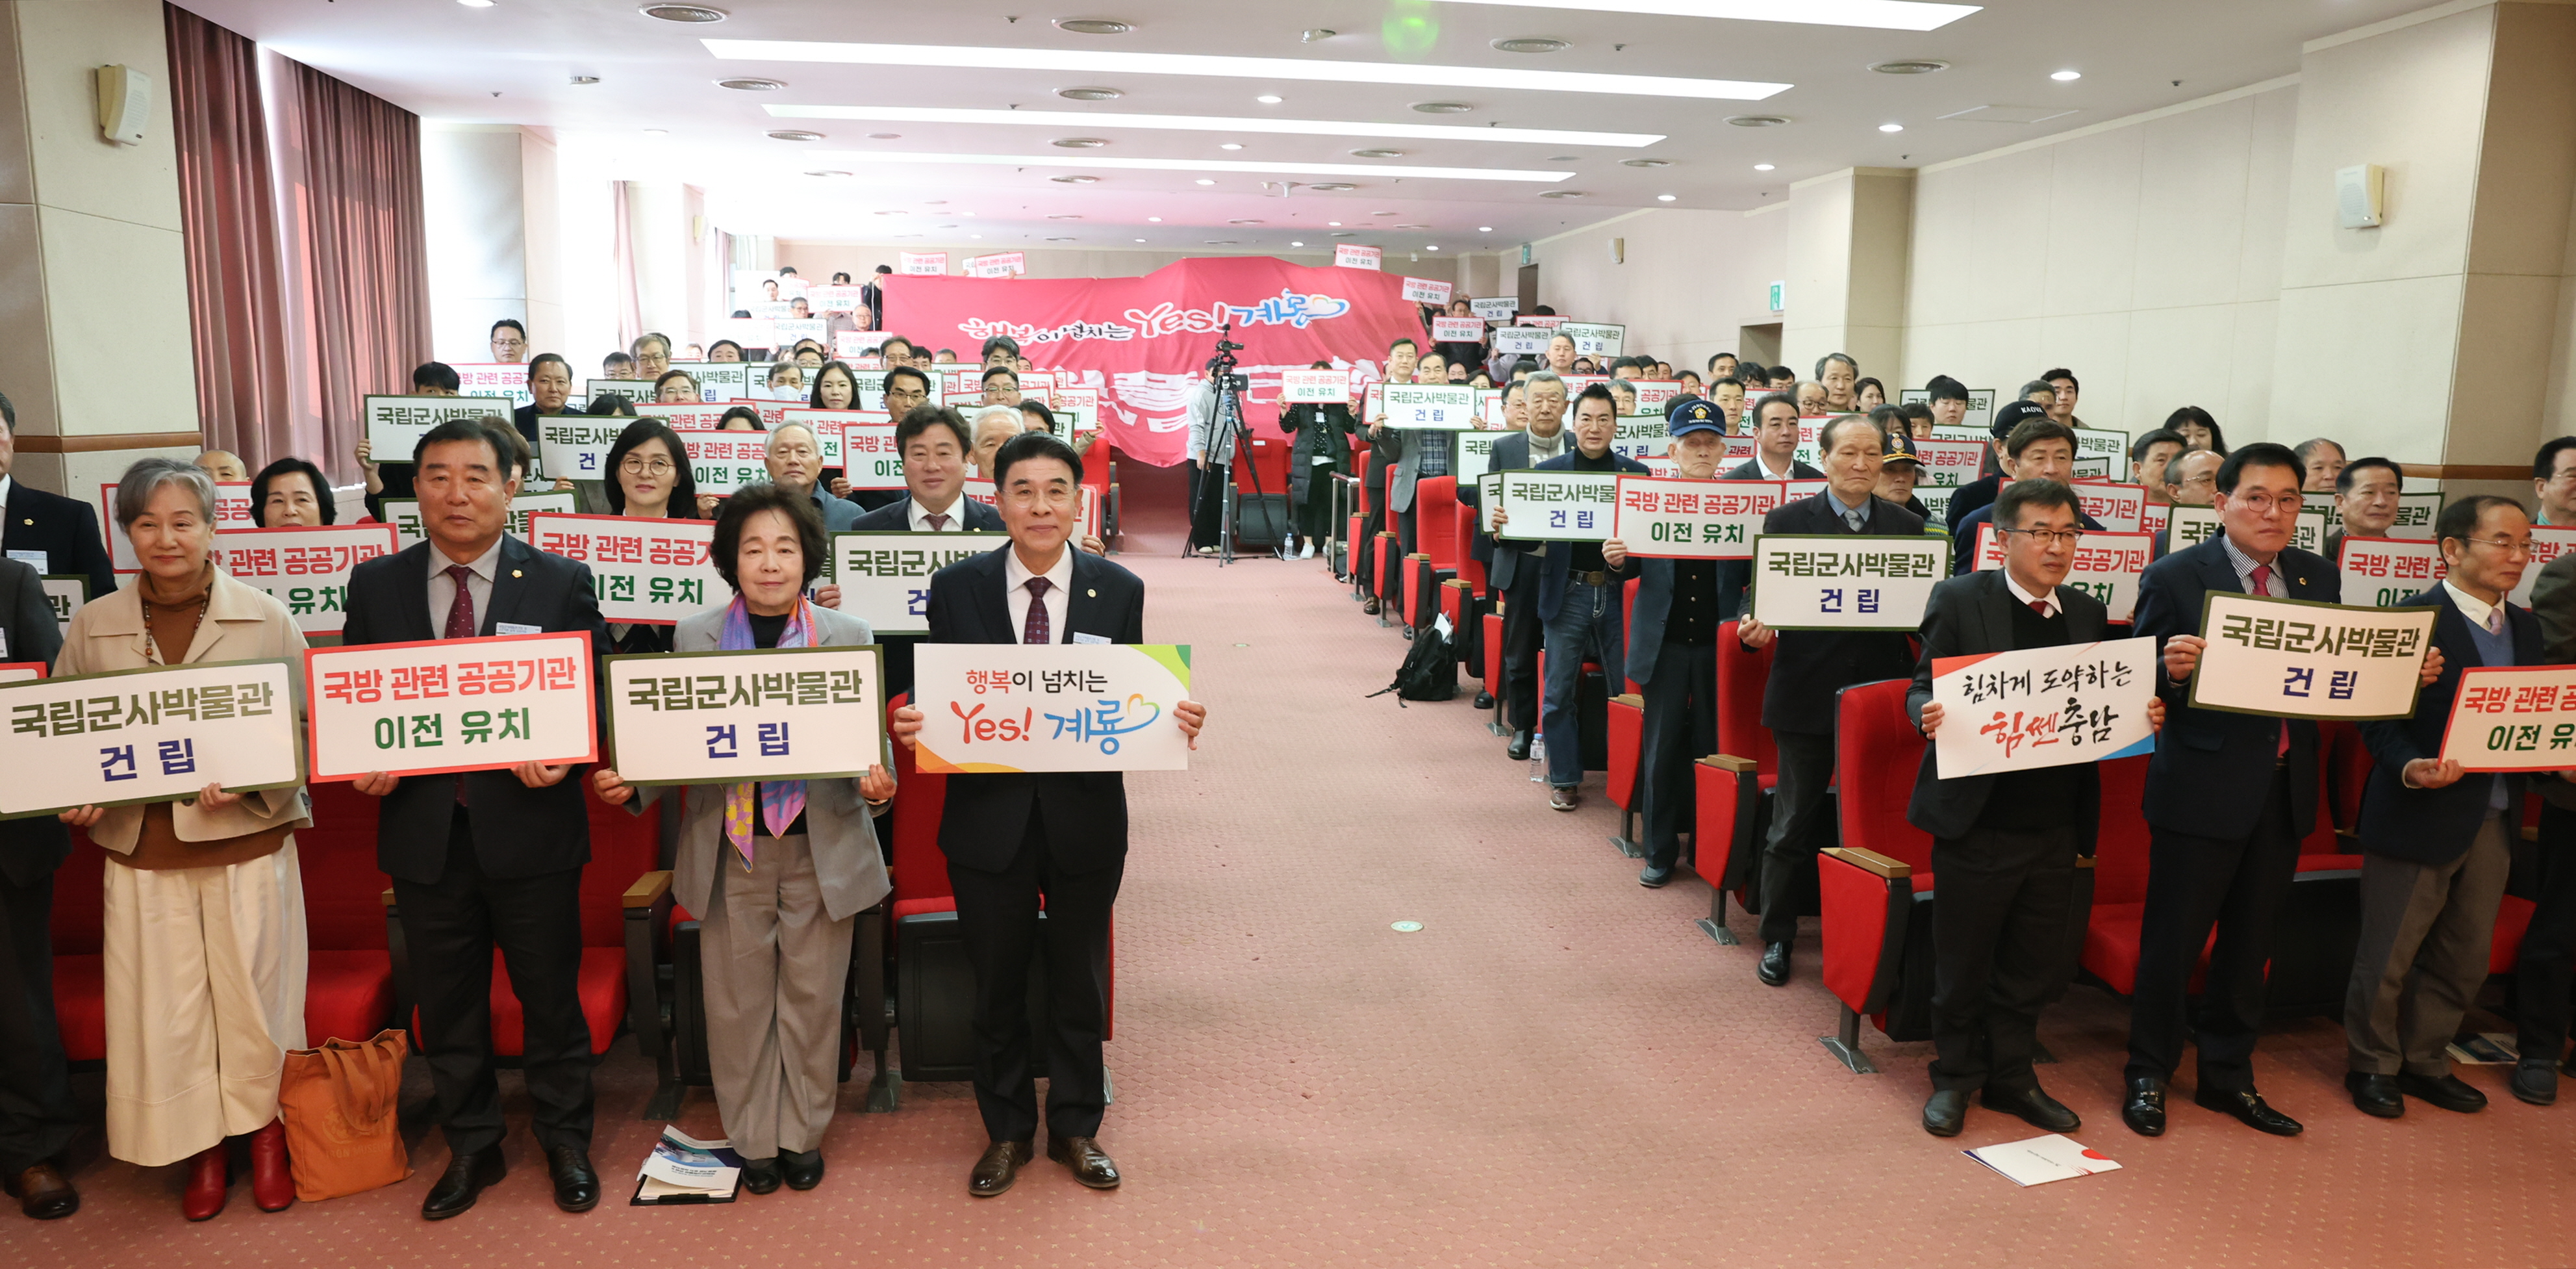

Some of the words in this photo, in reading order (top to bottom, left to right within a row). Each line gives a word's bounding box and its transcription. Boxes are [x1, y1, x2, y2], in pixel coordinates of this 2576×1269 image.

[1582, 342, 1591, 350] 건
[1595, 342, 1603, 351] 립
[477, 372, 498, 385] 관련
[1286, 375, 1300, 385] 국방
[1302, 375, 1317, 385] 관련
[1318, 375, 1346, 385] 공공기관
[1298, 387, 1315, 397] 이전
[1319, 387, 1335, 397] 유치
[1390, 391, 1469, 405] 국립군사박물관
[669, 414, 696, 429] 관련
[1415, 409, 1426, 421] 건
[1433, 409, 1444, 421] 립
[704, 442, 732, 459] 관련
[850, 436, 879, 453] 국방
[579, 453, 596, 470] 건
[1936, 451, 1978, 466] 공공기관
[695, 467, 728, 484] 이전
[1512, 483, 1616, 502] 국립군사박물
[1625, 490, 1660, 511] 국방
[1664, 493, 1699, 514] 관련
[1703, 494, 1776, 516] 공공기관
[1550, 511, 1567, 528] 건
[1577, 511, 1594, 528] 립
[1651, 522, 1693, 543] 이전
[1702, 523, 1744, 544] 유치
[596, 535, 642, 563] 관련
[2073, 548, 2145, 573] 공공기관
[229, 548, 278, 576] 관련
[1769, 551, 1936, 578] 국립군사박물관
[2349, 553, 2390, 577] 국방
[2394, 556, 2430, 579] 관련
[650, 577, 703, 605] 유치
[1821, 589, 1843, 613] 건
[1858, 589, 1880, 613] 립
[2222, 614, 2420, 658] 국립군사박물관
[324, 669, 383, 704] 국방
[390, 664, 449, 701] 관련
[457, 657, 577, 696] 공공기관
[628, 669, 862, 711] 국립군사박물관
[965, 669, 1033, 694] 행복이
[1041, 669, 1108, 694] 넘치는
[1963, 669, 2031, 704] 힘차게
[2041, 660, 2132, 693] 도약하는
[2282, 667, 2314, 697] 건
[2329, 671, 2358, 699] 립
[12, 682, 273, 737] 국립군사박물관
[2465, 687, 2512, 713] 국방
[2513, 686, 2559, 713] 관련
[374, 713, 444, 750] 이전
[461, 707, 531, 745] 유치
[950, 700, 1033, 744] Yes!
[1044, 699, 1133, 756] 계룡
[2487, 724, 2542, 751] 이전
[706, 724, 738, 759] 건
[758, 722, 790, 756] 립
[100, 744, 138, 782] 건
[158, 738, 196, 776] 립
